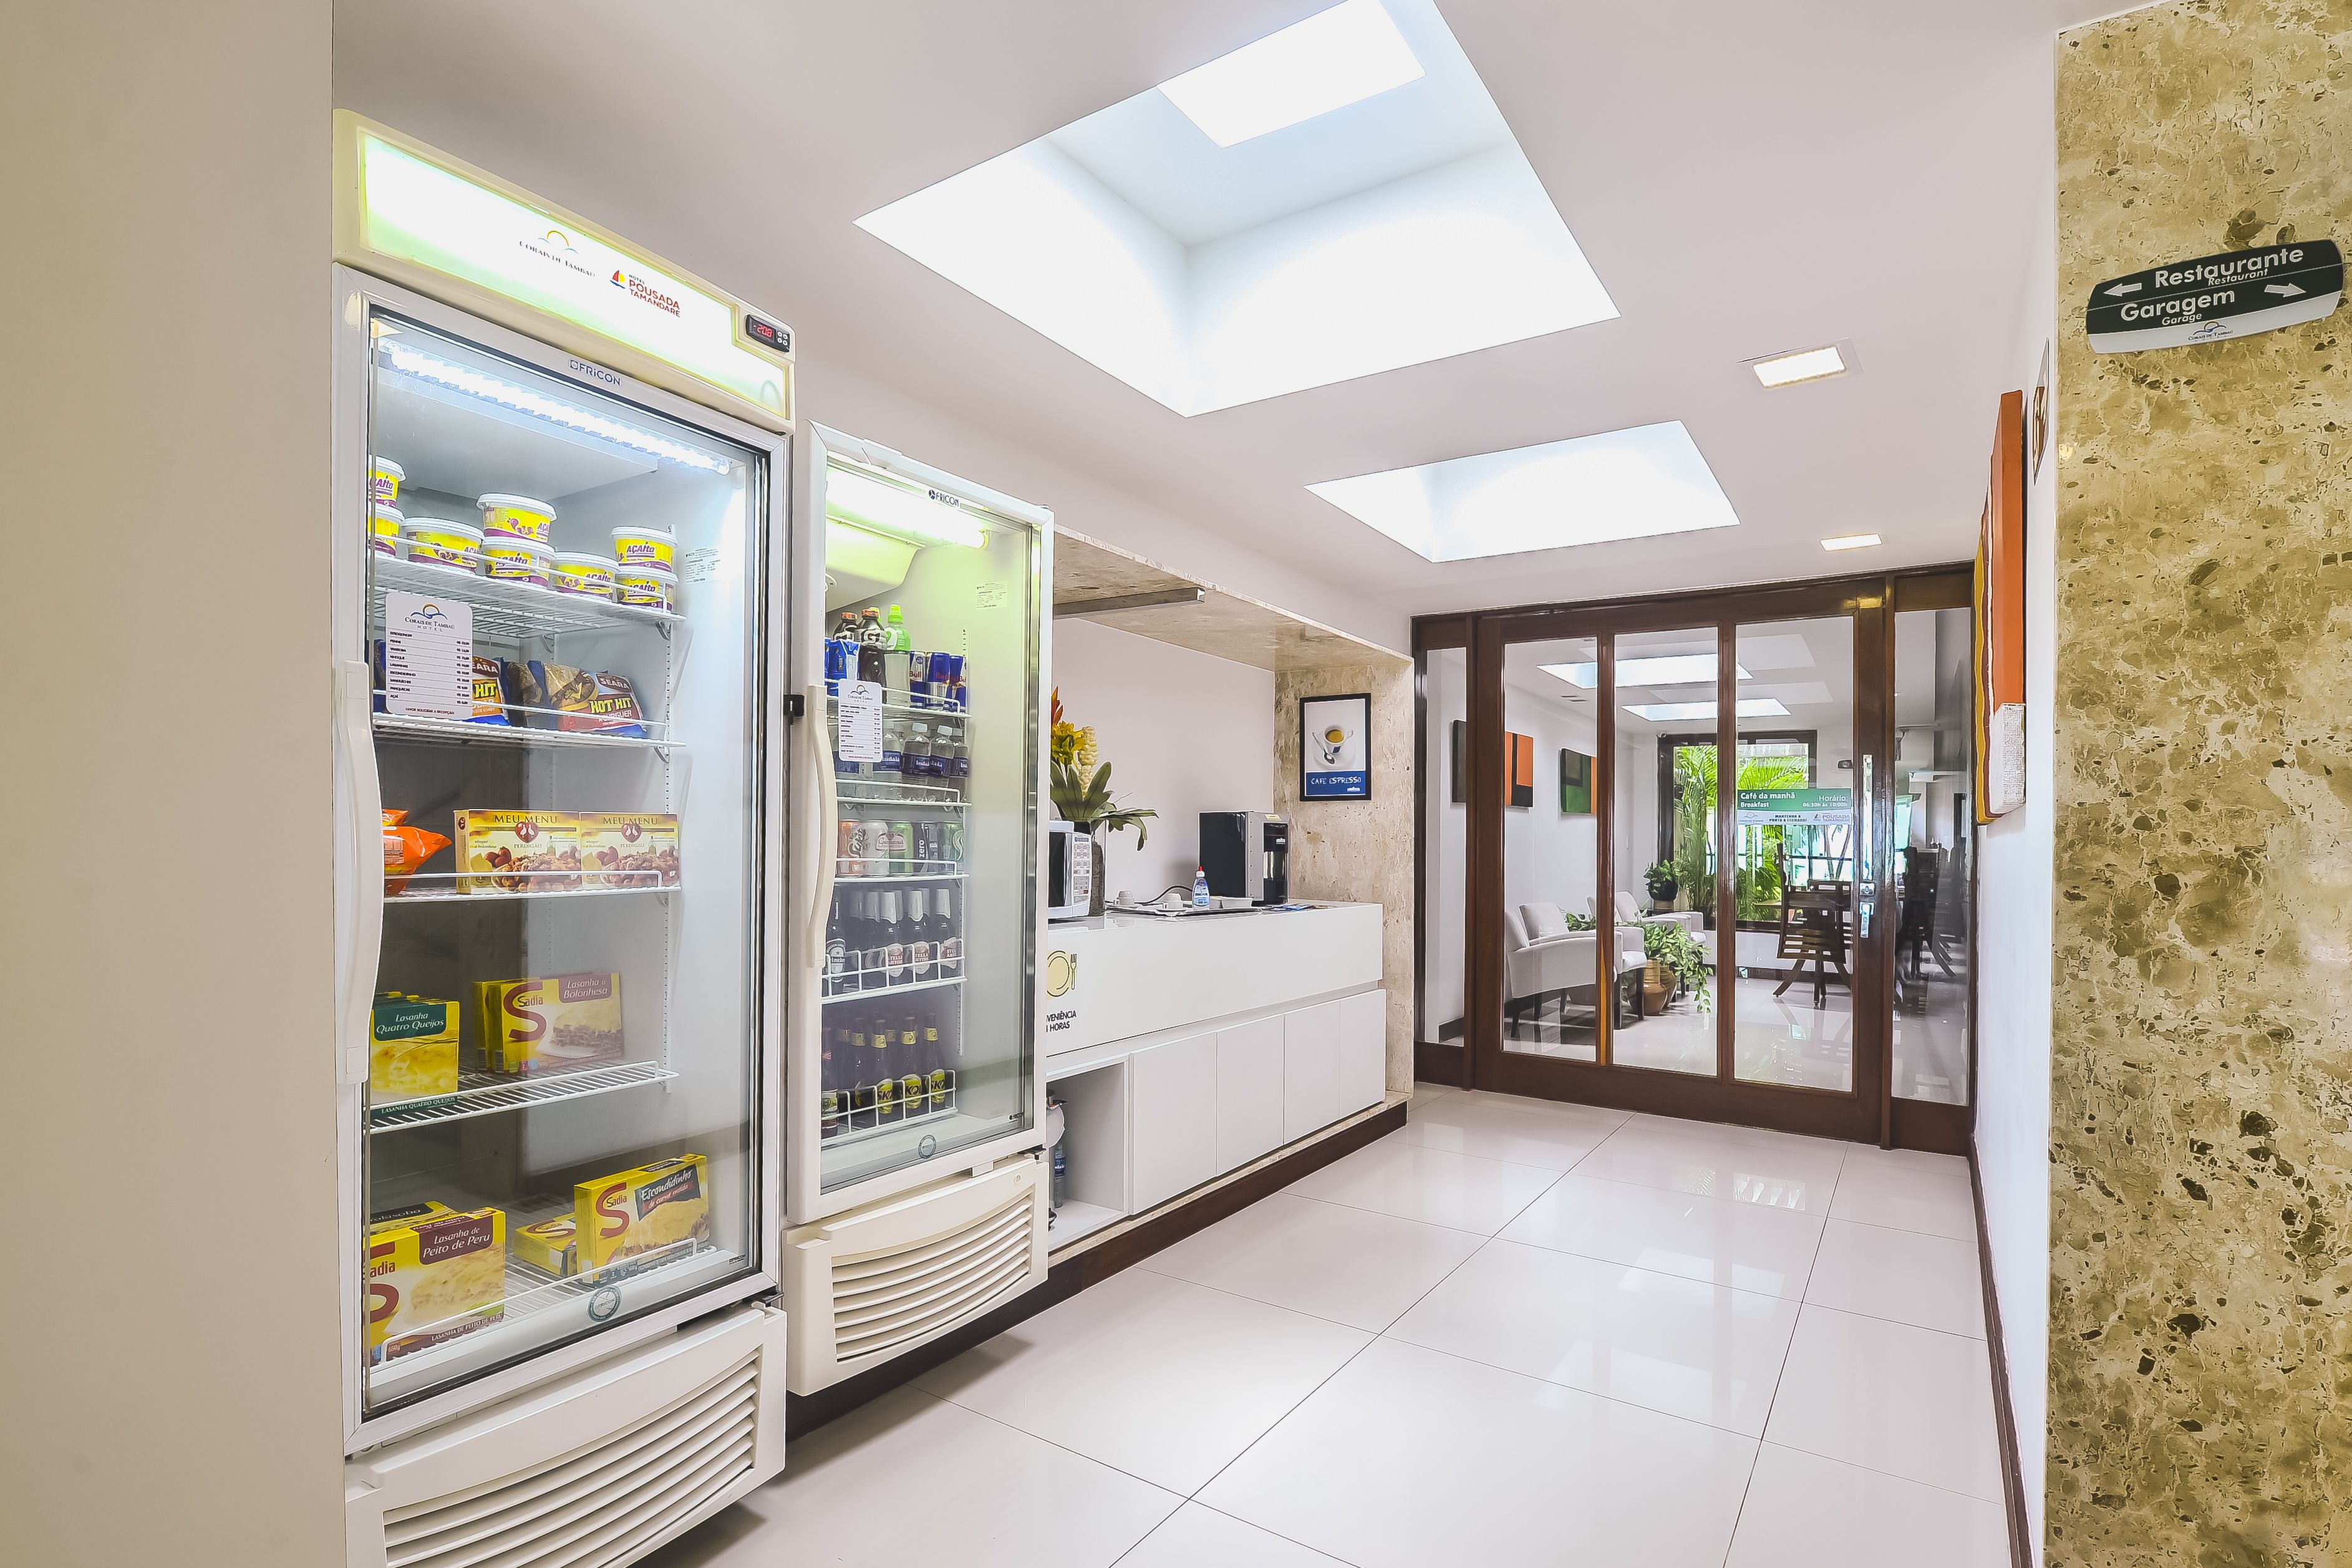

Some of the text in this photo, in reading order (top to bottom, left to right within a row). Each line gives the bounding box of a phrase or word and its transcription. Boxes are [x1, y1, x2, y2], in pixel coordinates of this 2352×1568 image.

[2155, 249, 2304, 288] Restaurante
[629, 274, 645, 284] HOTEL
[2208, 268, 2268, 287] Restaurant
[629, 279, 680, 310] POUSADA
[2121, 290, 2235, 321] Garagem
[2162, 313, 2202, 326] Garage
[936, 492, 959, 507] FRICON
[405, 617, 425, 625] CORAIS
[475, 682, 497, 698] HIT
[600, 677, 631, 690] SEARA
[590, 697, 632, 714] HOT HIT
[494, 815, 557, 824] MEU MENU
[567, 978, 599, 989] Lasanha
[563, 986, 608, 999] Bolonhesa
[517, 995, 544, 1007] Sadia
[395, 1012, 428, 1022] Lasanha
[376, 1019, 444, 1035] Quatro Queijos
[1050, 1021, 1070, 1032] HORAS
[382, 1096, 455, 1114] LASANHA QUATRO QUEIJOS
[641, 1168, 694, 1201] Escondidinho
[606, 1194, 627, 1207] Sadia
[434, 1229, 469, 1244] Lasanha
[423, 1232, 490, 1258] Peito de Peru
[369, 1261, 395, 1278] adia
[432, 1328, 457, 1342] LASANHA
[457, 1326, 465, 1334] DE
[465, 1320, 481, 1331] PEITO
